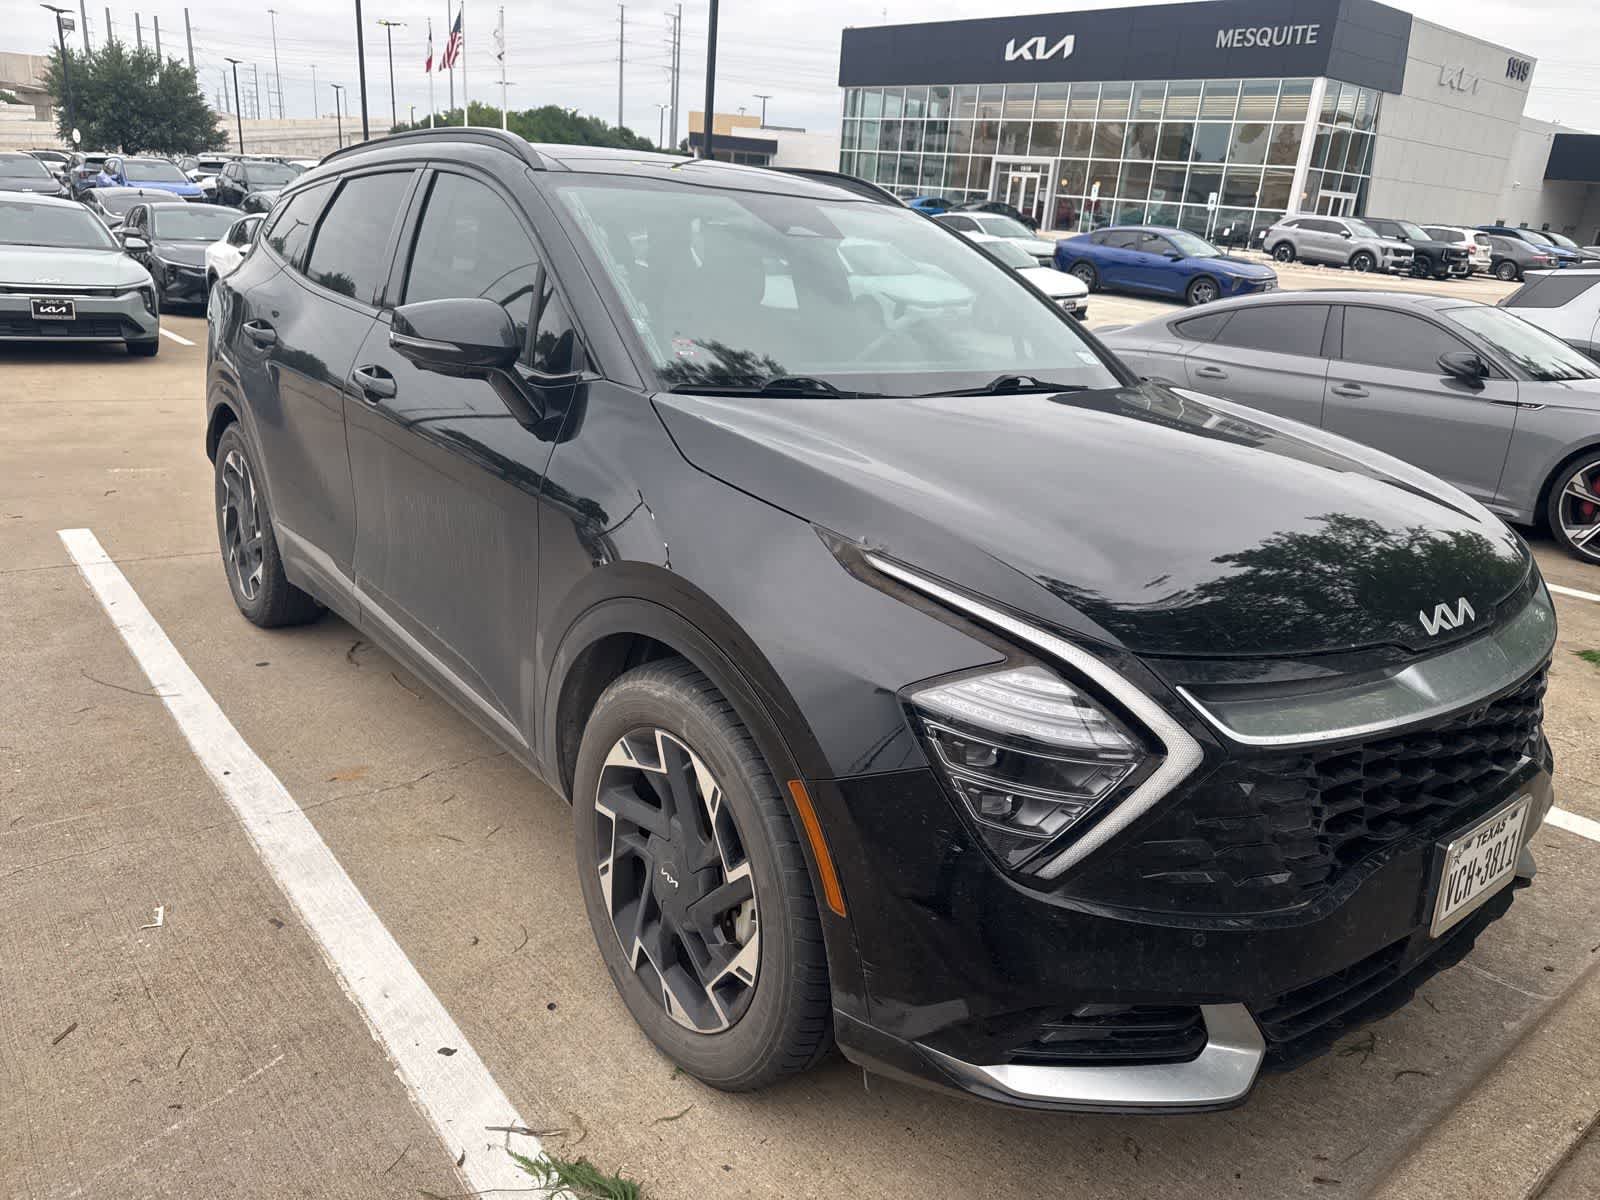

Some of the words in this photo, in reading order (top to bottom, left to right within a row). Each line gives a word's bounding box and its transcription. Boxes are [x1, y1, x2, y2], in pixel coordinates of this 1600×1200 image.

[1005, 34, 1075, 61] KIA
[1216, 24, 1320, 48] MESQUITE
[1505, 57, 1531, 82] 1919
[1419, 597, 1476, 636] KIA
[1476, 821, 1506, 849] TEXAS
